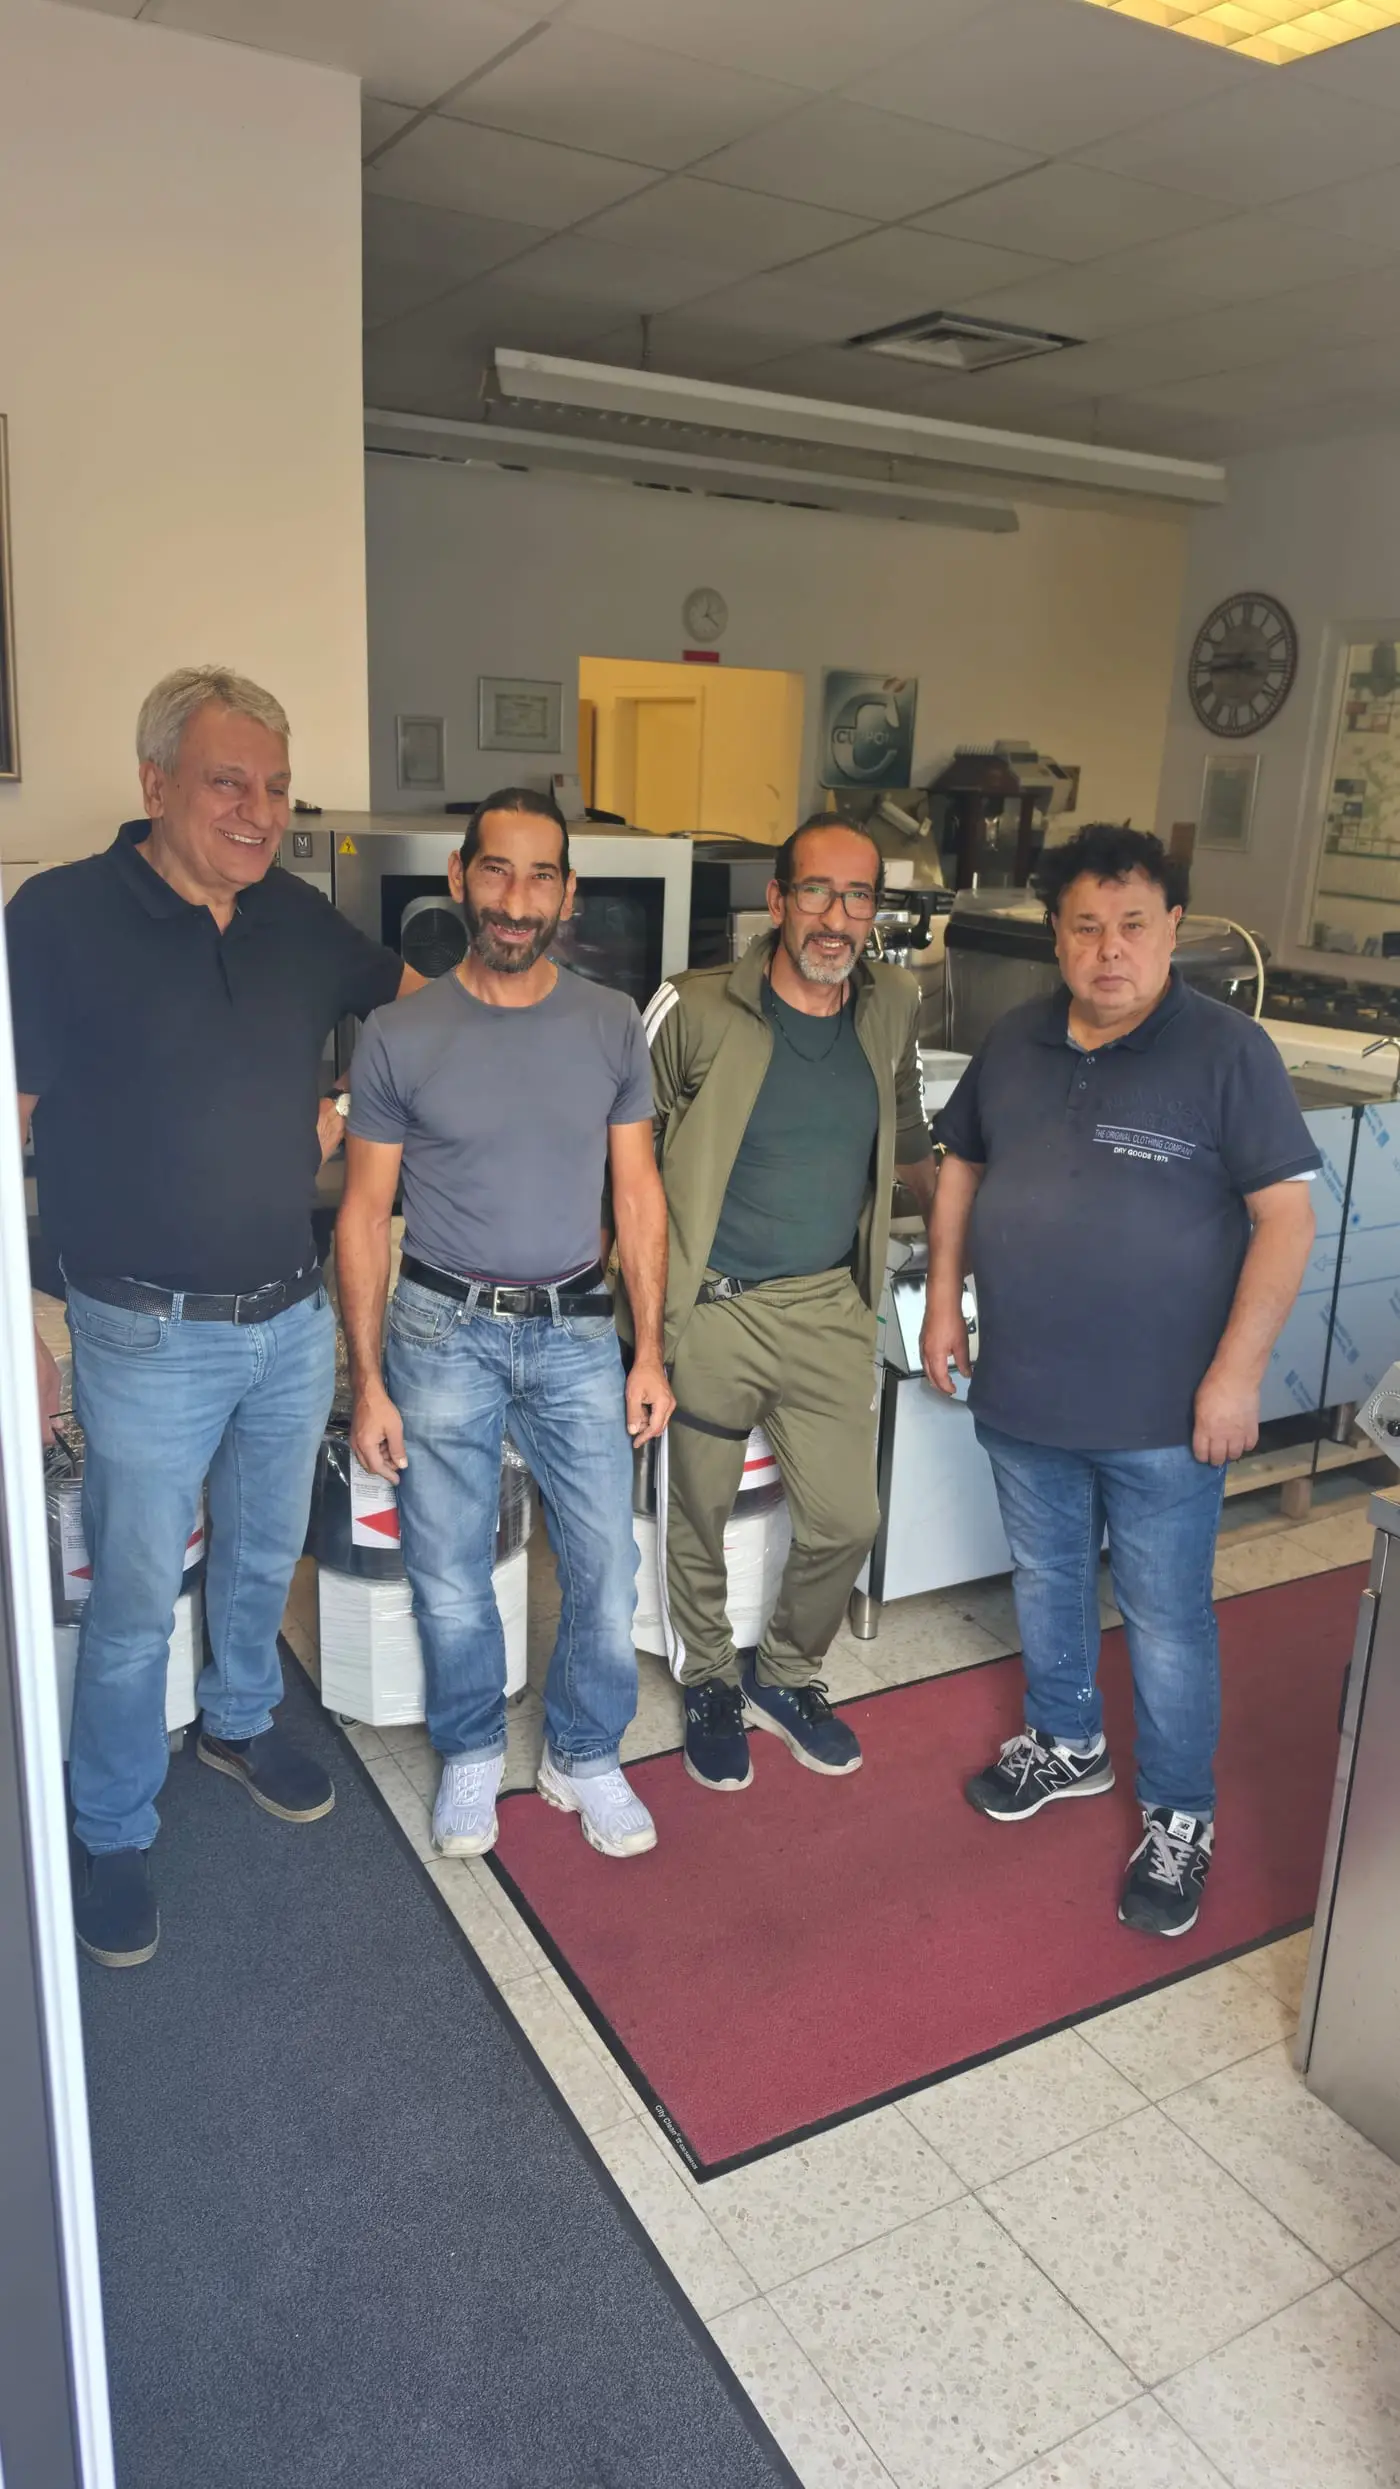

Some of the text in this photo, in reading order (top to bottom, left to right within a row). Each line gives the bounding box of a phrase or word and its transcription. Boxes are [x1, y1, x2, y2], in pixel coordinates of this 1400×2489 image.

[298, 836, 308, 848] M
[1095, 1129, 1193, 1156] THE ORIGINAL CLOTHING COMPANY
[1127, 1149, 1151, 1160] GOODS
[1033, 1760, 1073, 1794] N
[655, 2105, 666, 2118] City
